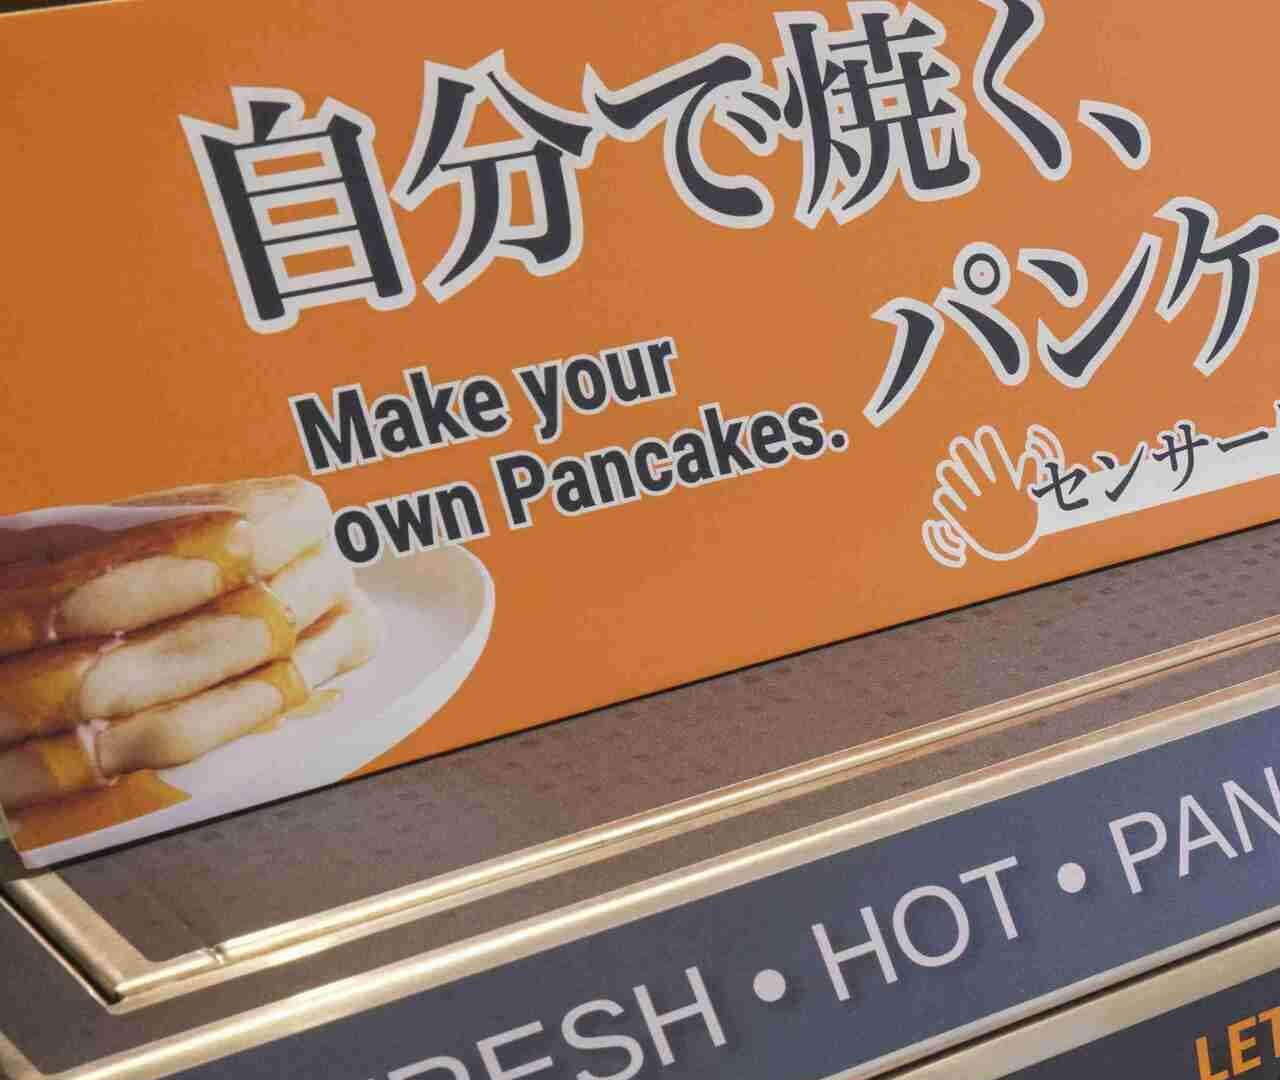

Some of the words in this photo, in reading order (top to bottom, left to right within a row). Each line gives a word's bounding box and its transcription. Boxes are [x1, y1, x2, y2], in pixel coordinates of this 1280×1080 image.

[188, 0, 1148, 327] 自分で焼く、
[290, 368, 510, 475] Make
[519, 335, 677, 442] your
[331, 478, 491, 565] own
[496, 401, 850, 529] Pancakes.
[811, 856, 1020, 1002] HOT
